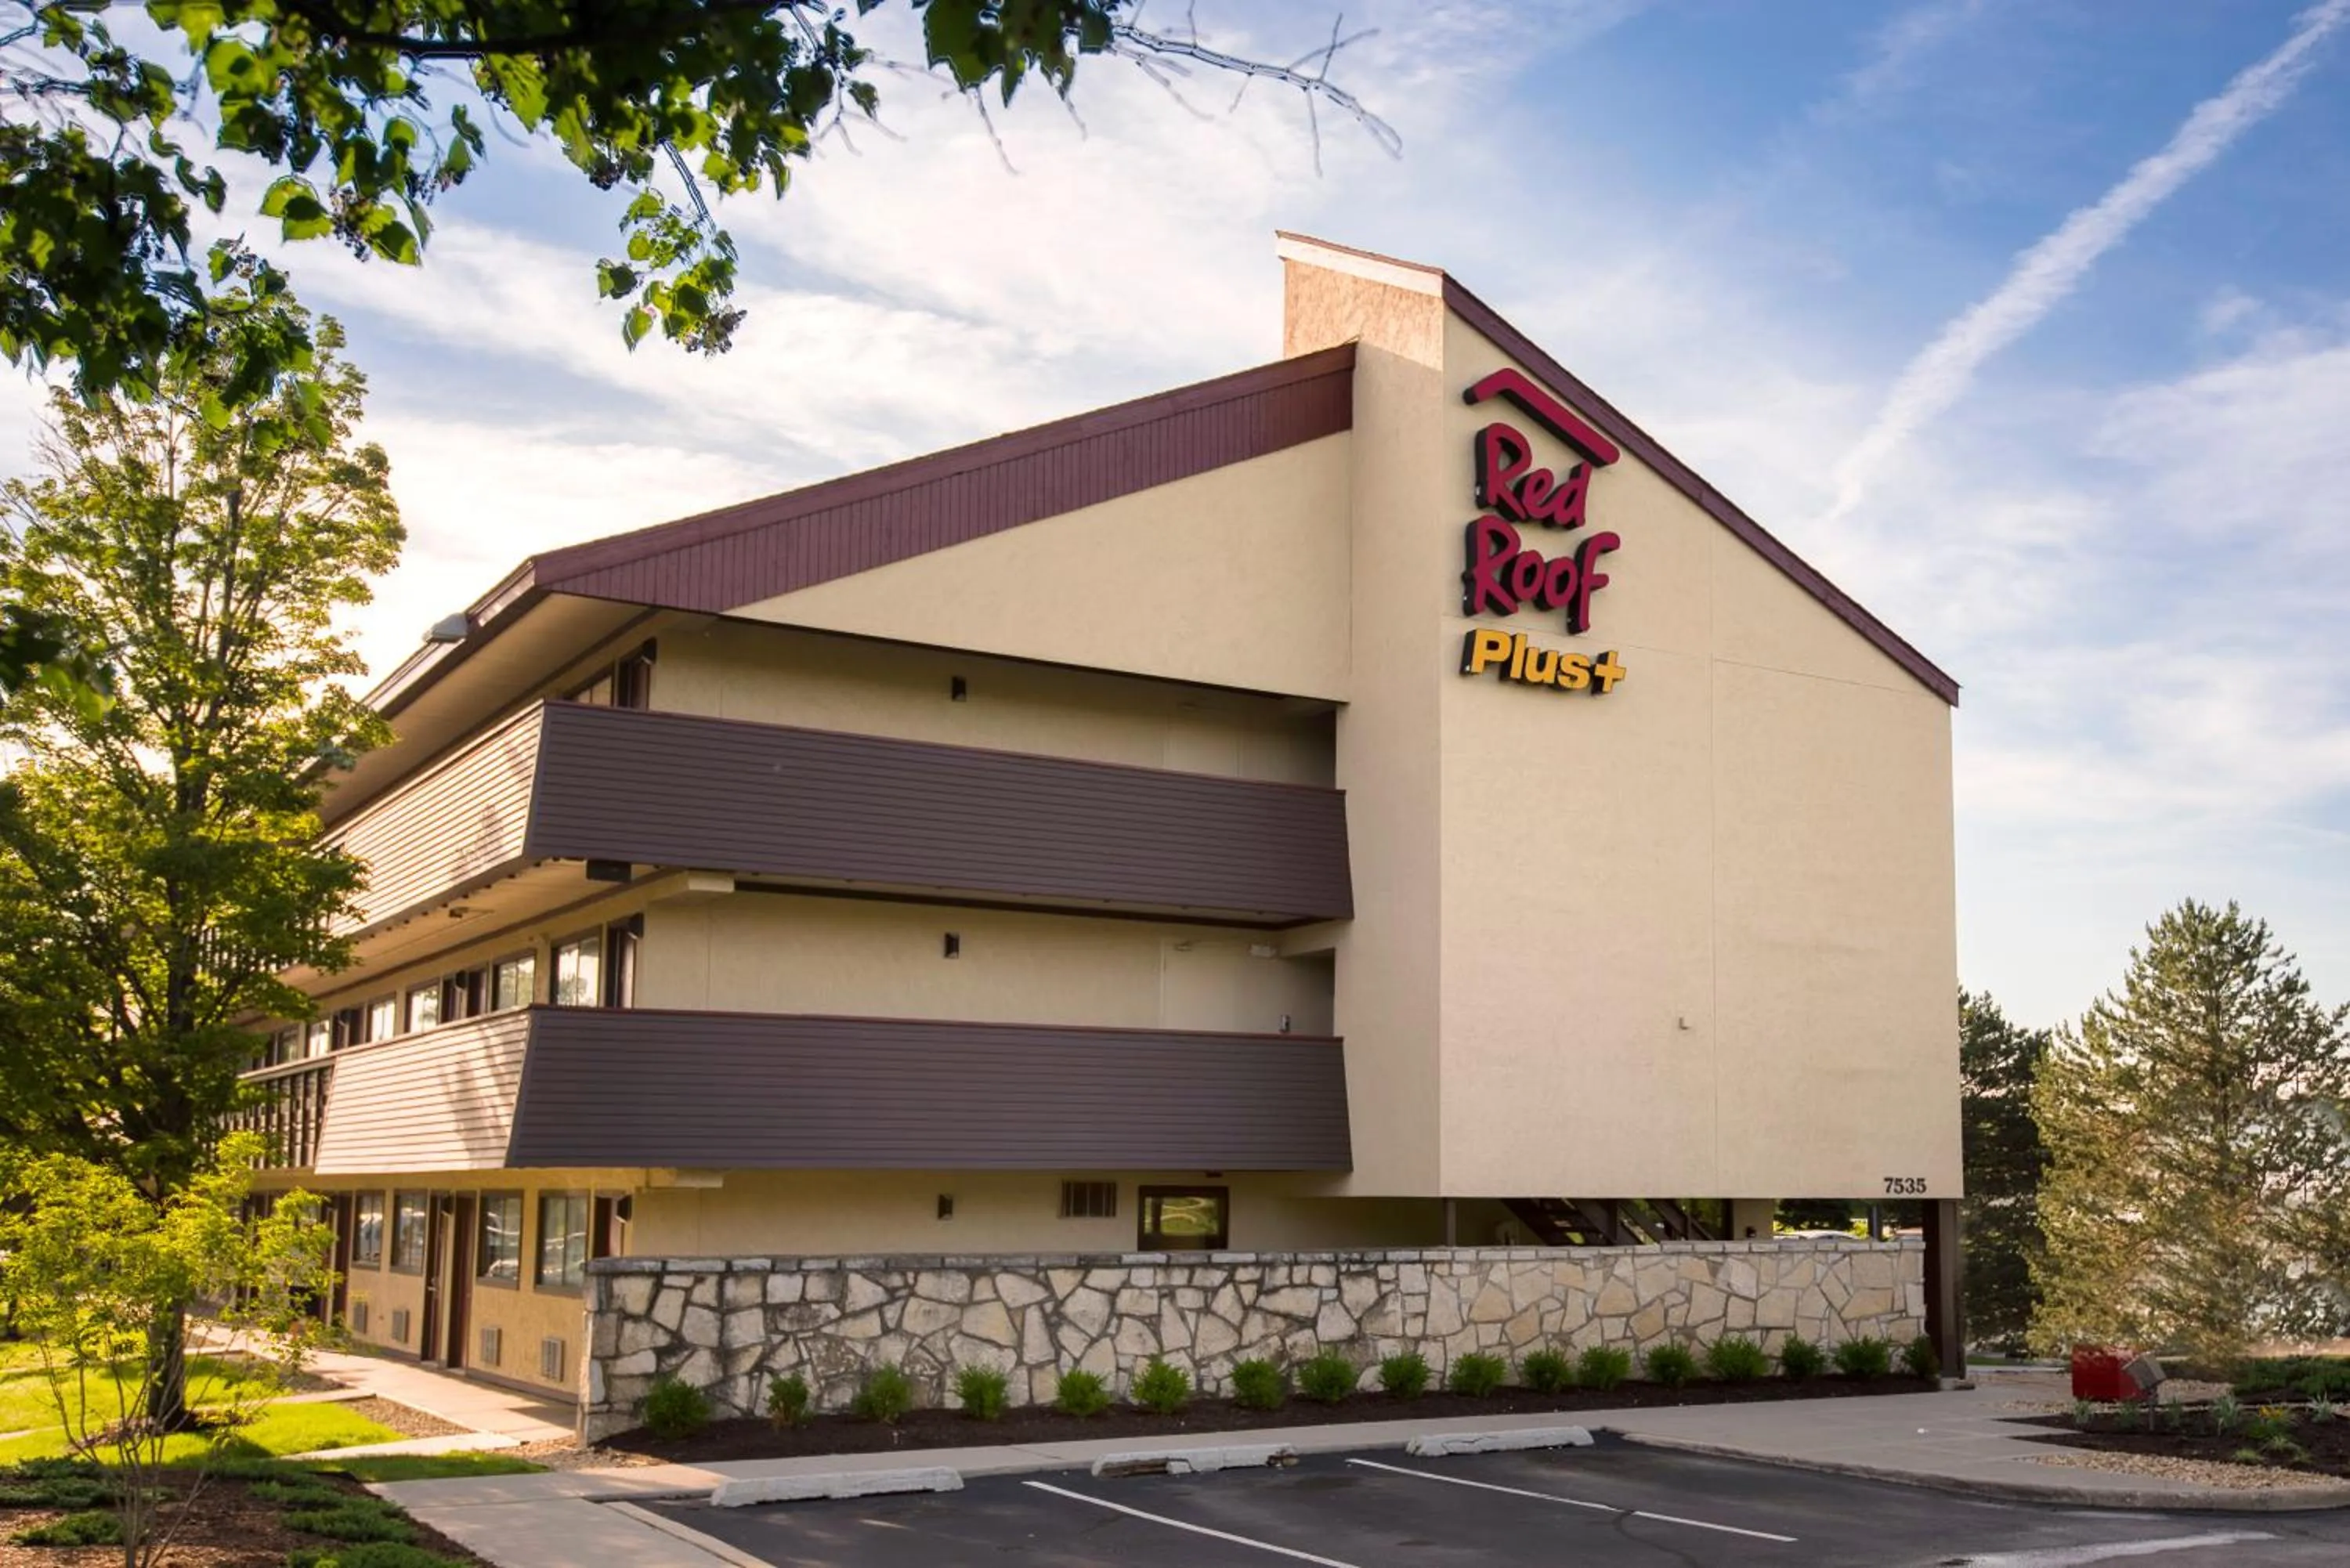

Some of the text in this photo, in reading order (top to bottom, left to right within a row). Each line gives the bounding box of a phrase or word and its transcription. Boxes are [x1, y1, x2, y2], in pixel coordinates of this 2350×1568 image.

[1478, 422, 1593, 527] Red
[1466, 515, 1621, 633] Roof
[1465, 628, 1626, 694] Plus+
[1883, 1177, 1927, 1194] 7535
